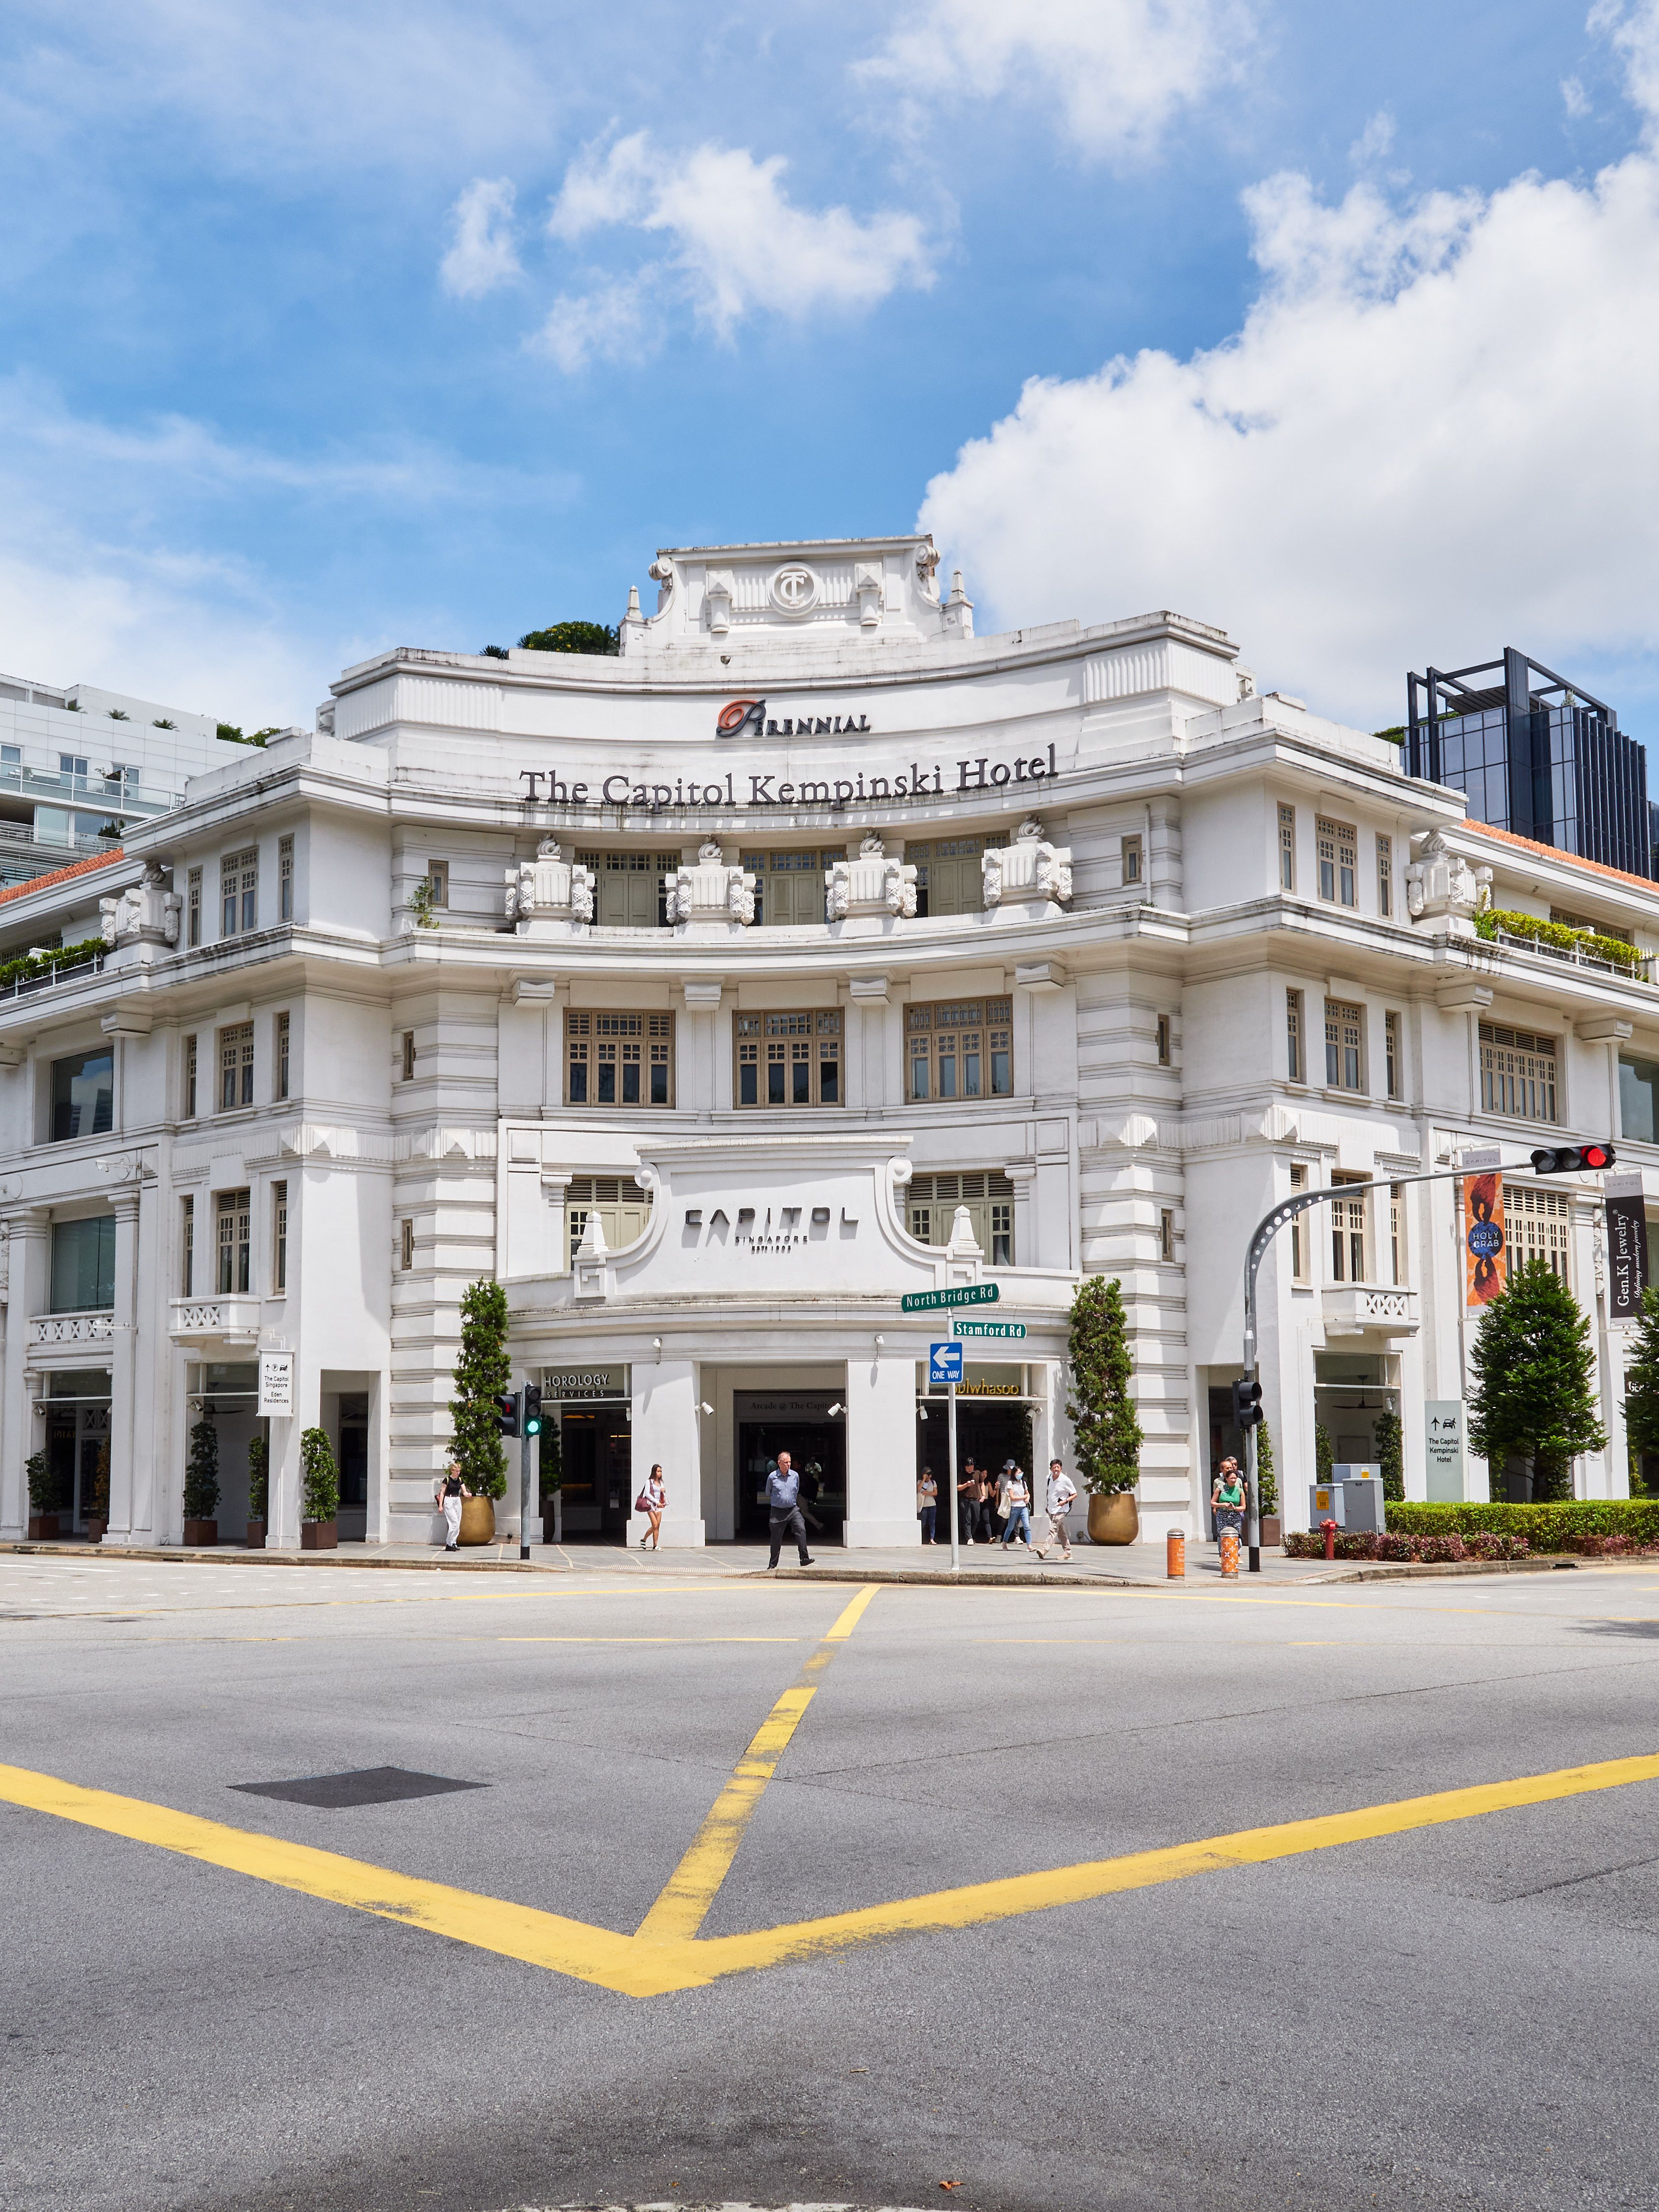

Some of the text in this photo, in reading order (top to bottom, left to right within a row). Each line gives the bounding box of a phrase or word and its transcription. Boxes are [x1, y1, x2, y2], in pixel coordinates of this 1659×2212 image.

[519, 743, 1059, 814] The Capitol Kempinski Hotel
[685, 1207, 859, 1225] CAPITOL
[1473, 1239, 1499, 1248] CRAB
[1631, 1219, 1643, 1298] Defining modern jewelry
[1617, 1264, 1629, 1307] Gen.K
[907, 1286, 993, 1307] North Bridge Rd
[956, 1323, 1022, 1337] Stamford Rd
[544, 1374, 608, 1387] HOROLOGY
[932, 1370, 960, 1379] ONE WAY
[547, 1390, 604, 1398] SERVICES
